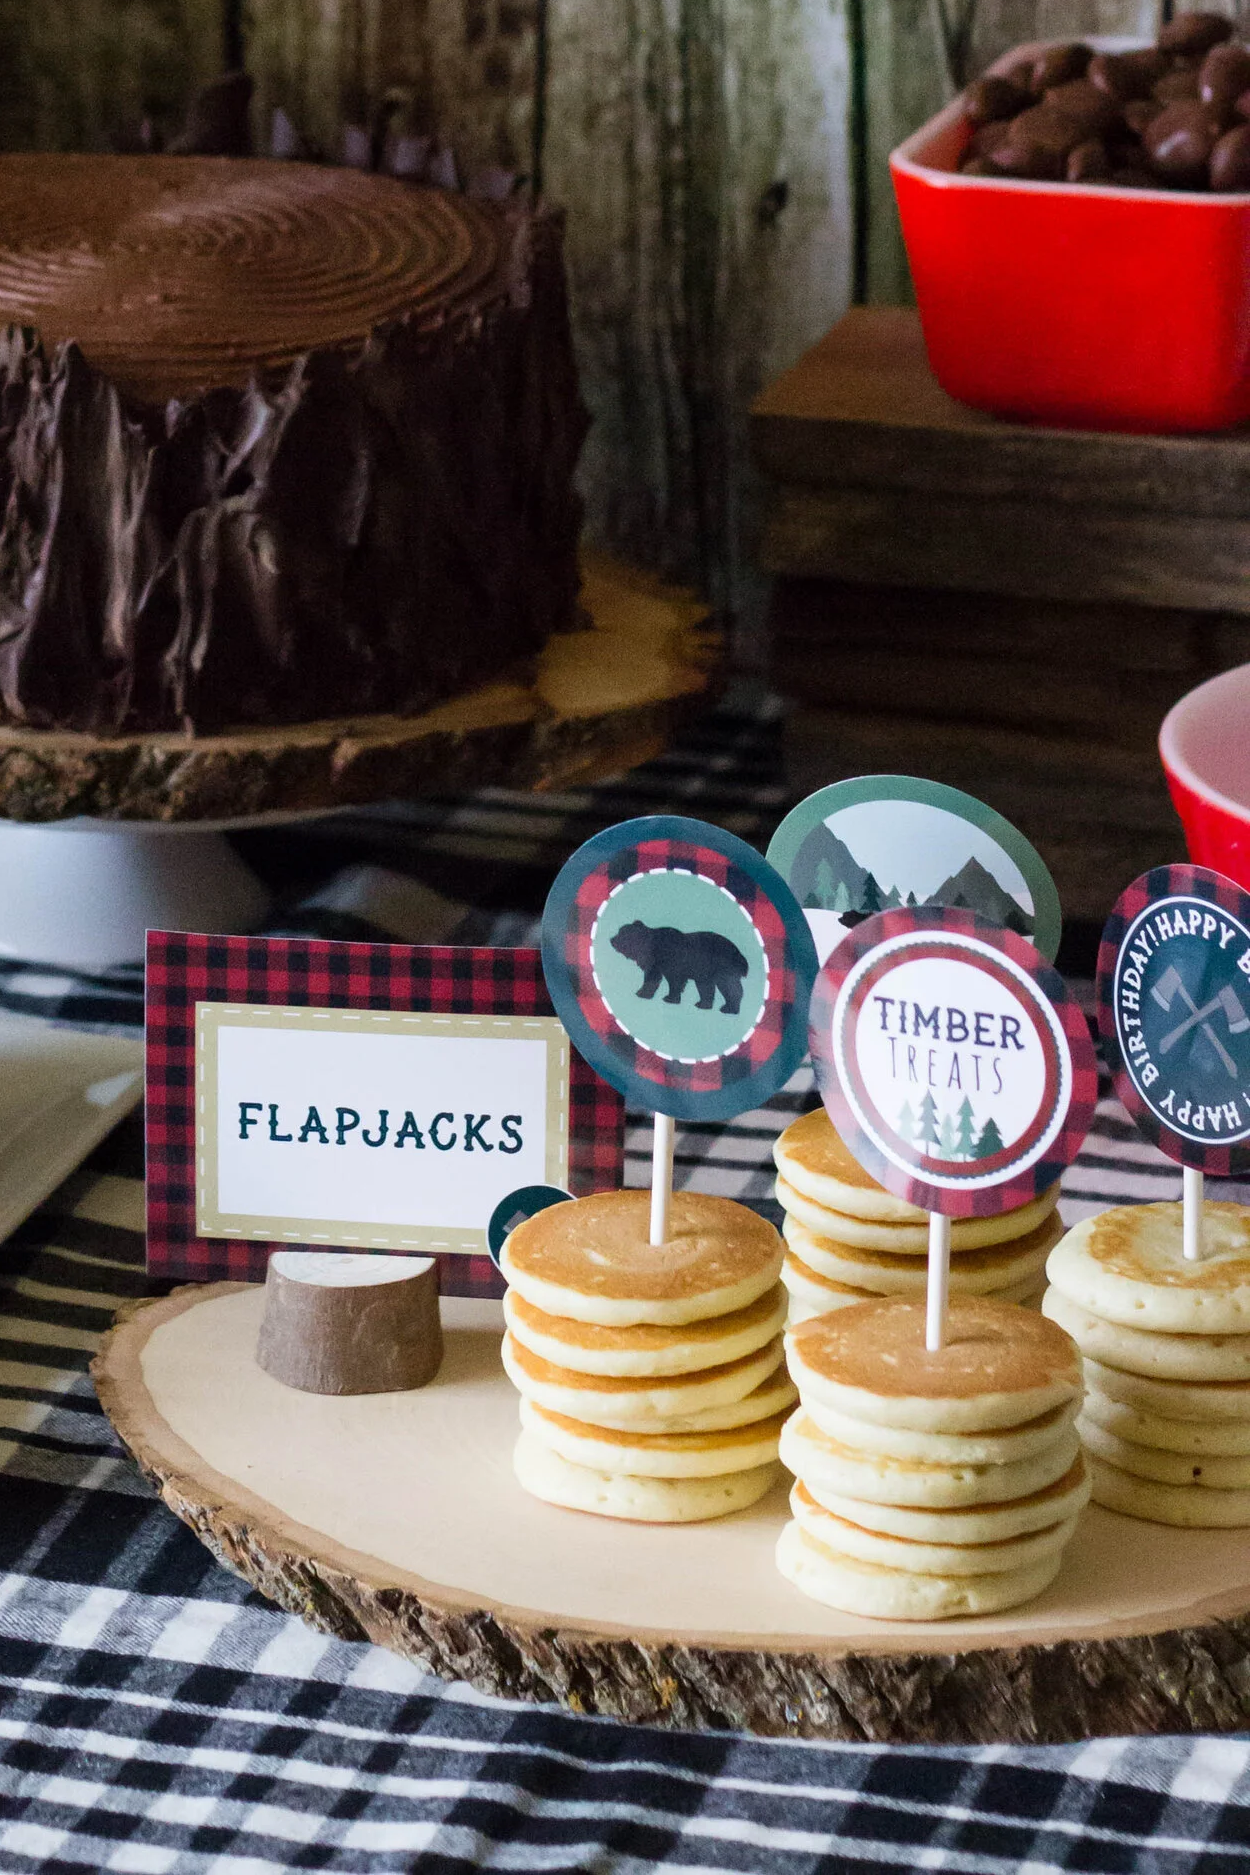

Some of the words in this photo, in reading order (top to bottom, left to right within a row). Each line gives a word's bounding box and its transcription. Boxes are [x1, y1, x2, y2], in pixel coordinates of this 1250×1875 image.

[1155, 908, 1236, 949] HAPPY
[873, 995, 1026, 1051] TIMBER
[1121, 922, 1160, 1088] BIRTHDAY!
[885, 1036, 1004, 1096] TREATS
[237, 1101, 524, 1155] FLAPJACKS
[1158, 1089, 1242, 1132] HAPPY
